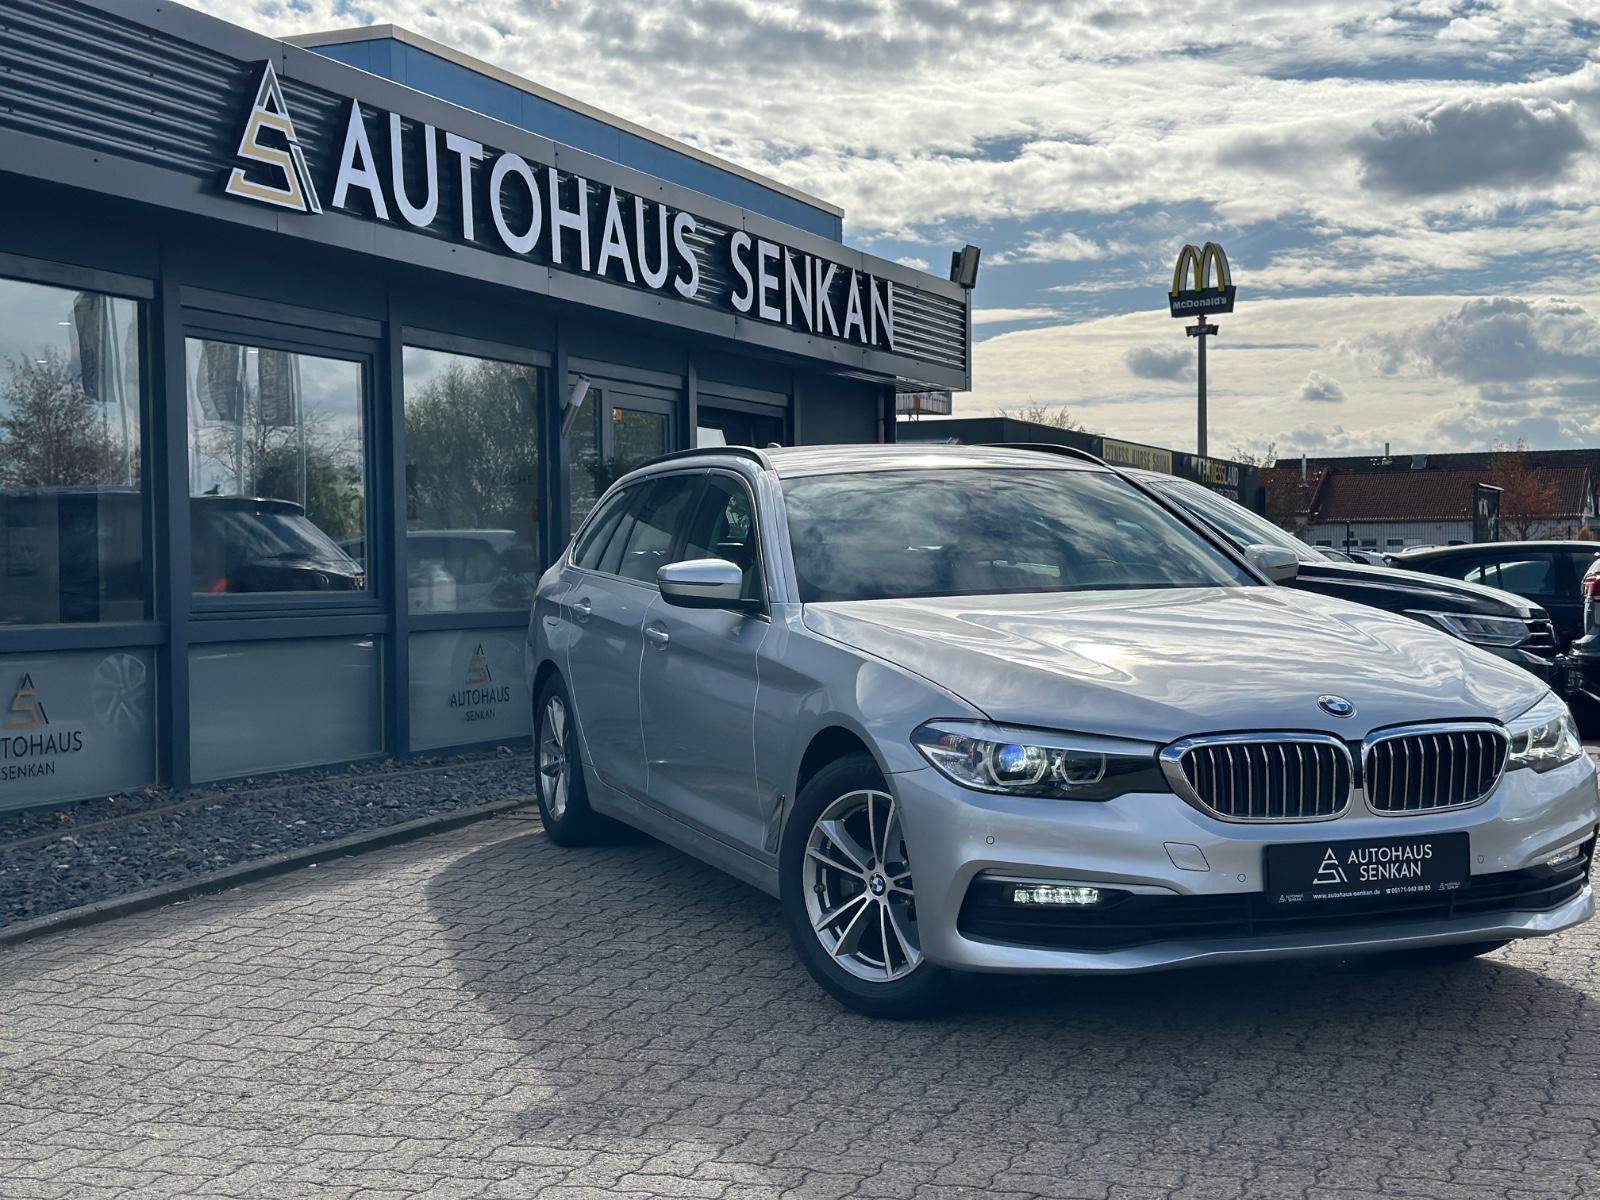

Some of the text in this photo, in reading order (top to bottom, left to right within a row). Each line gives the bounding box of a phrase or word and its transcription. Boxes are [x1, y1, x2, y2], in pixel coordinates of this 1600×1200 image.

[332, 98, 896, 351] AUTOHAUS SENKAN
[1172, 296, 1227, 310] McDonald's
[449, 686, 510, 708] AUTOHAUS
[465, 708, 496, 722] SENKAN
[0, 760, 55, 781] SENKAN
[1347, 844, 1433, 865] AUTOHAUS
[1359, 861, 1422, 882] SENKAN
[1312, 888, 1381, 900] www.autohaus-senkan.de
